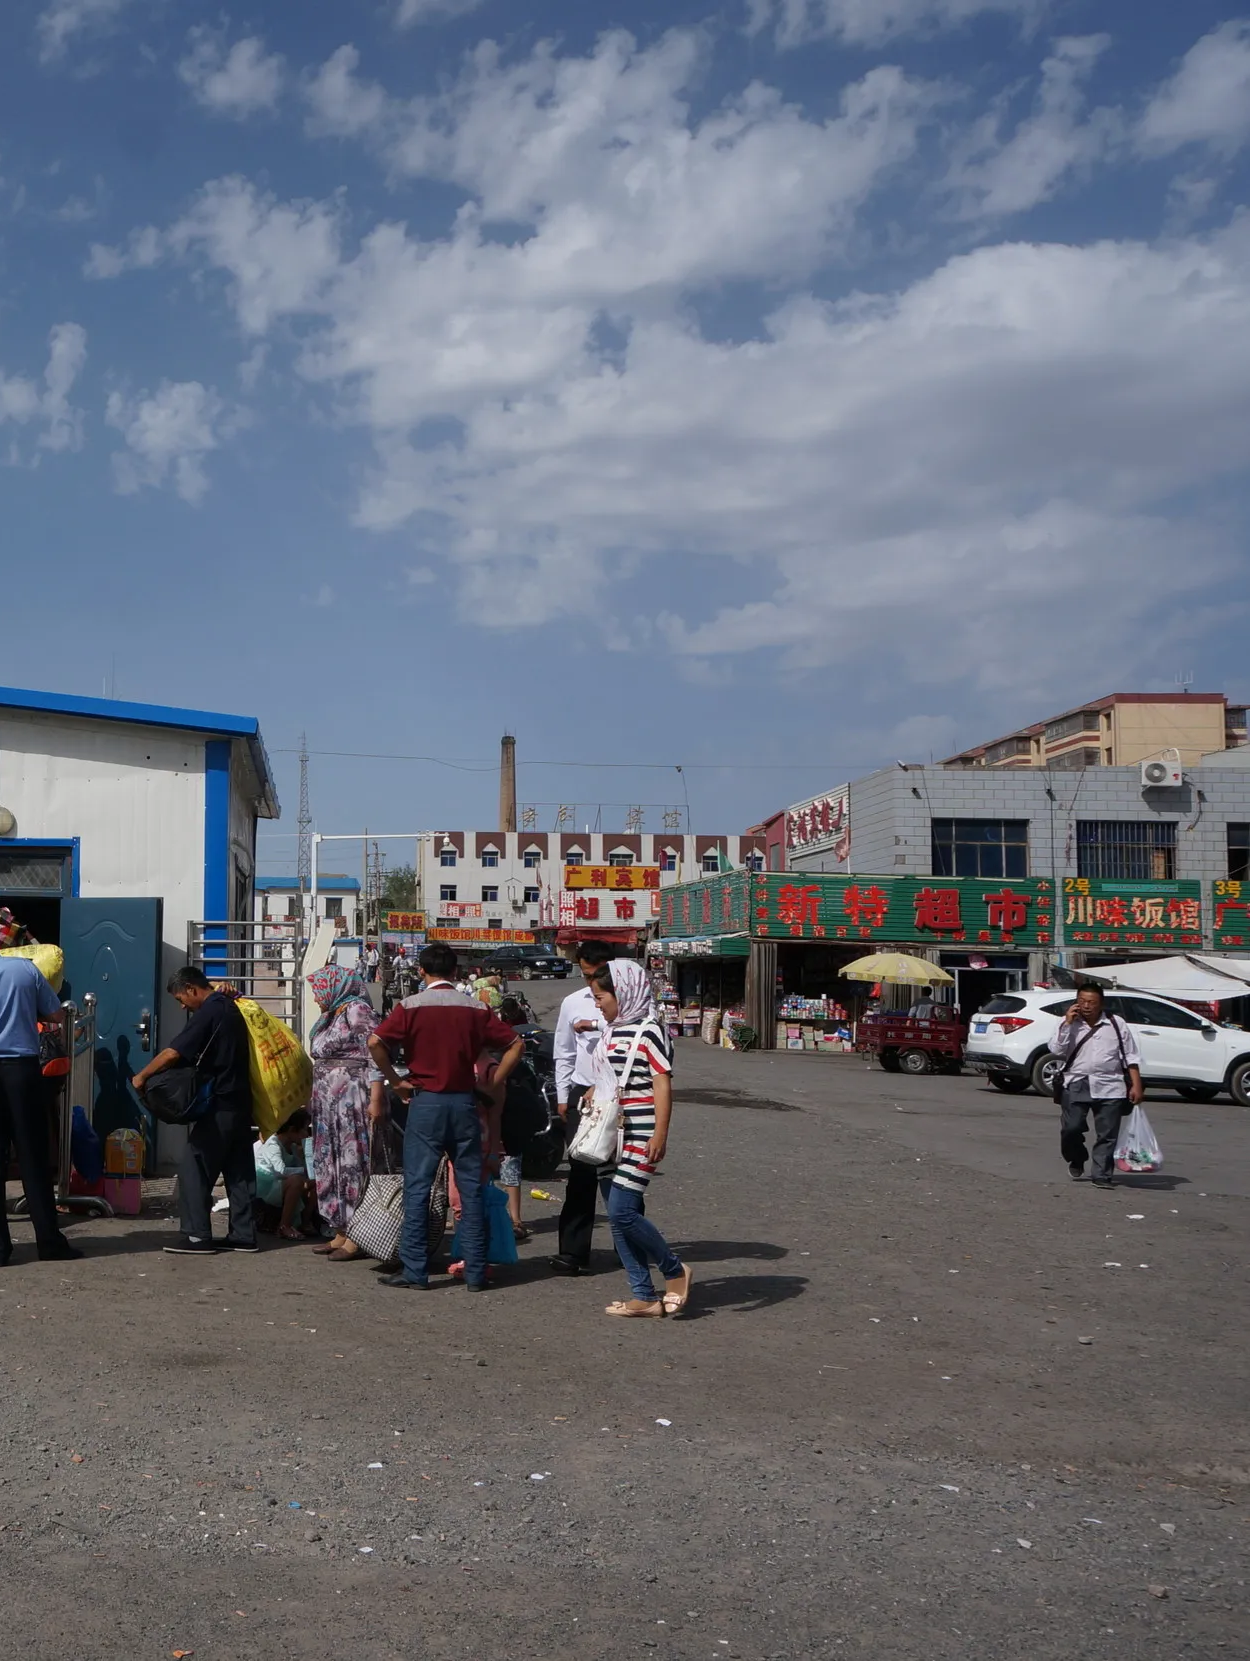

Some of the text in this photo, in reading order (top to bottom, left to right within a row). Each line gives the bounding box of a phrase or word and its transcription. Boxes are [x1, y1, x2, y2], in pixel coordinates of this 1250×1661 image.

[565, 867, 660, 888] 广利宾馆
[1064, 878, 1091, 896] 2号
[1214, 880, 1242, 899] 3号
[560, 891, 575, 926] 照相
[575, 897, 638, 920] 超市
[776, 883, 1032, 931] 新特超市
[1065, 895, 1200, 930] 川味饭馆
